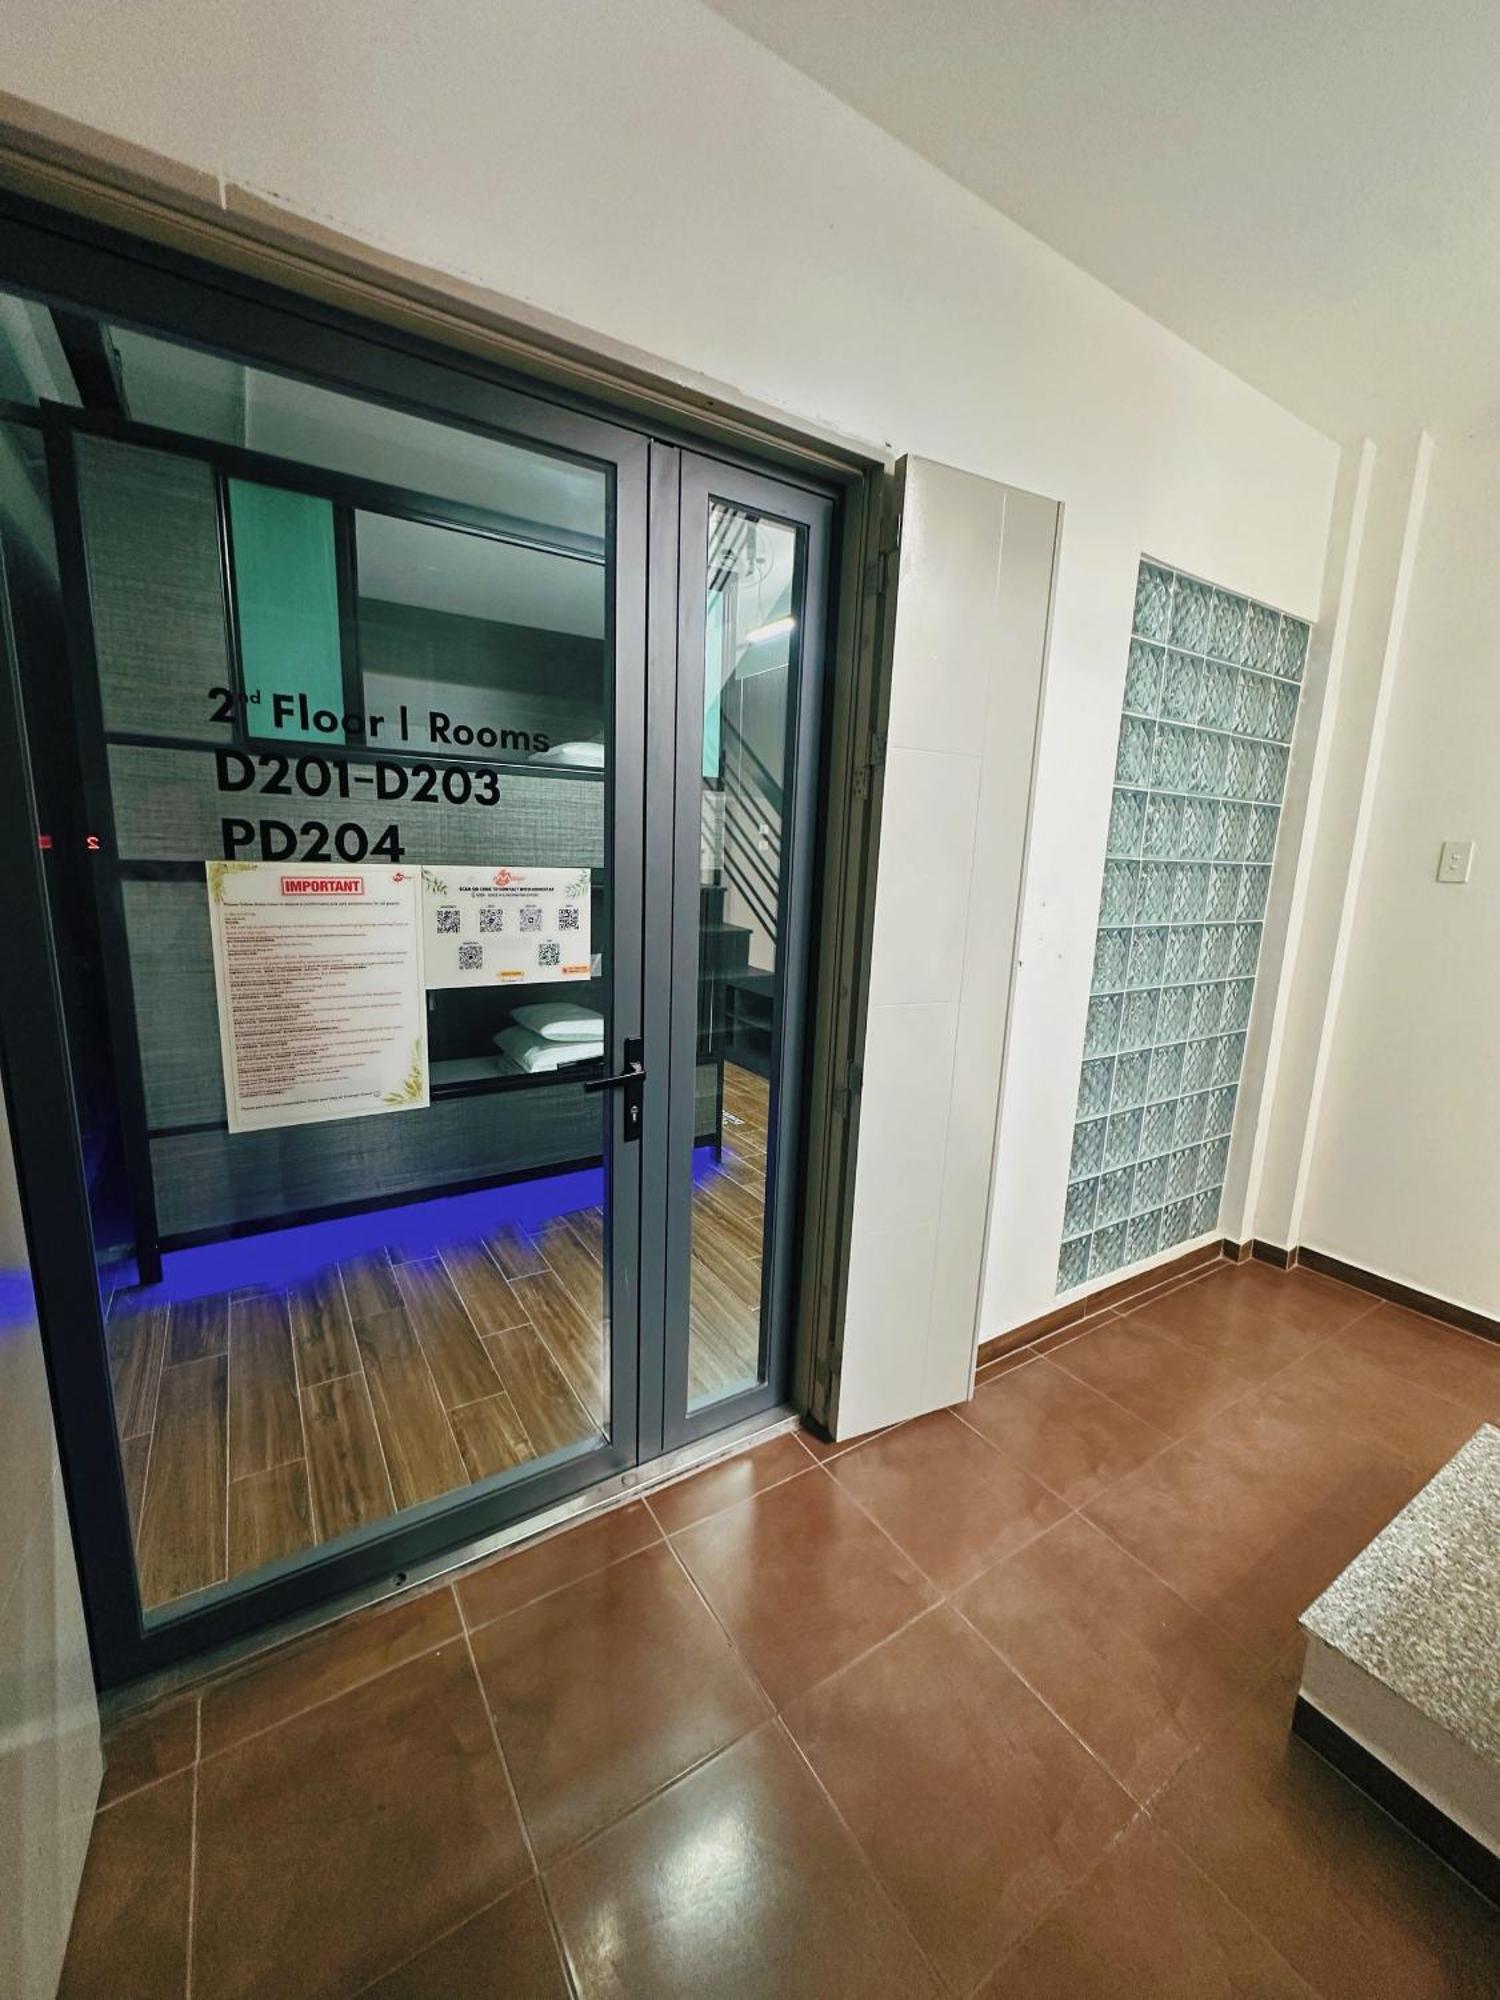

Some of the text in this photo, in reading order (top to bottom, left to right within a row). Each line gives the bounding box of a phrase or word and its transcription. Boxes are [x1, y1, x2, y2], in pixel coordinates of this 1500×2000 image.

[272, 692, 385, 738] Floor
[429, 711, 551, 753] Rooms
[215, 748, 501, 806] D201-D203
[220, 818, 406, 863] PD204
[285, 880, 361, 893] IMPORTANT
